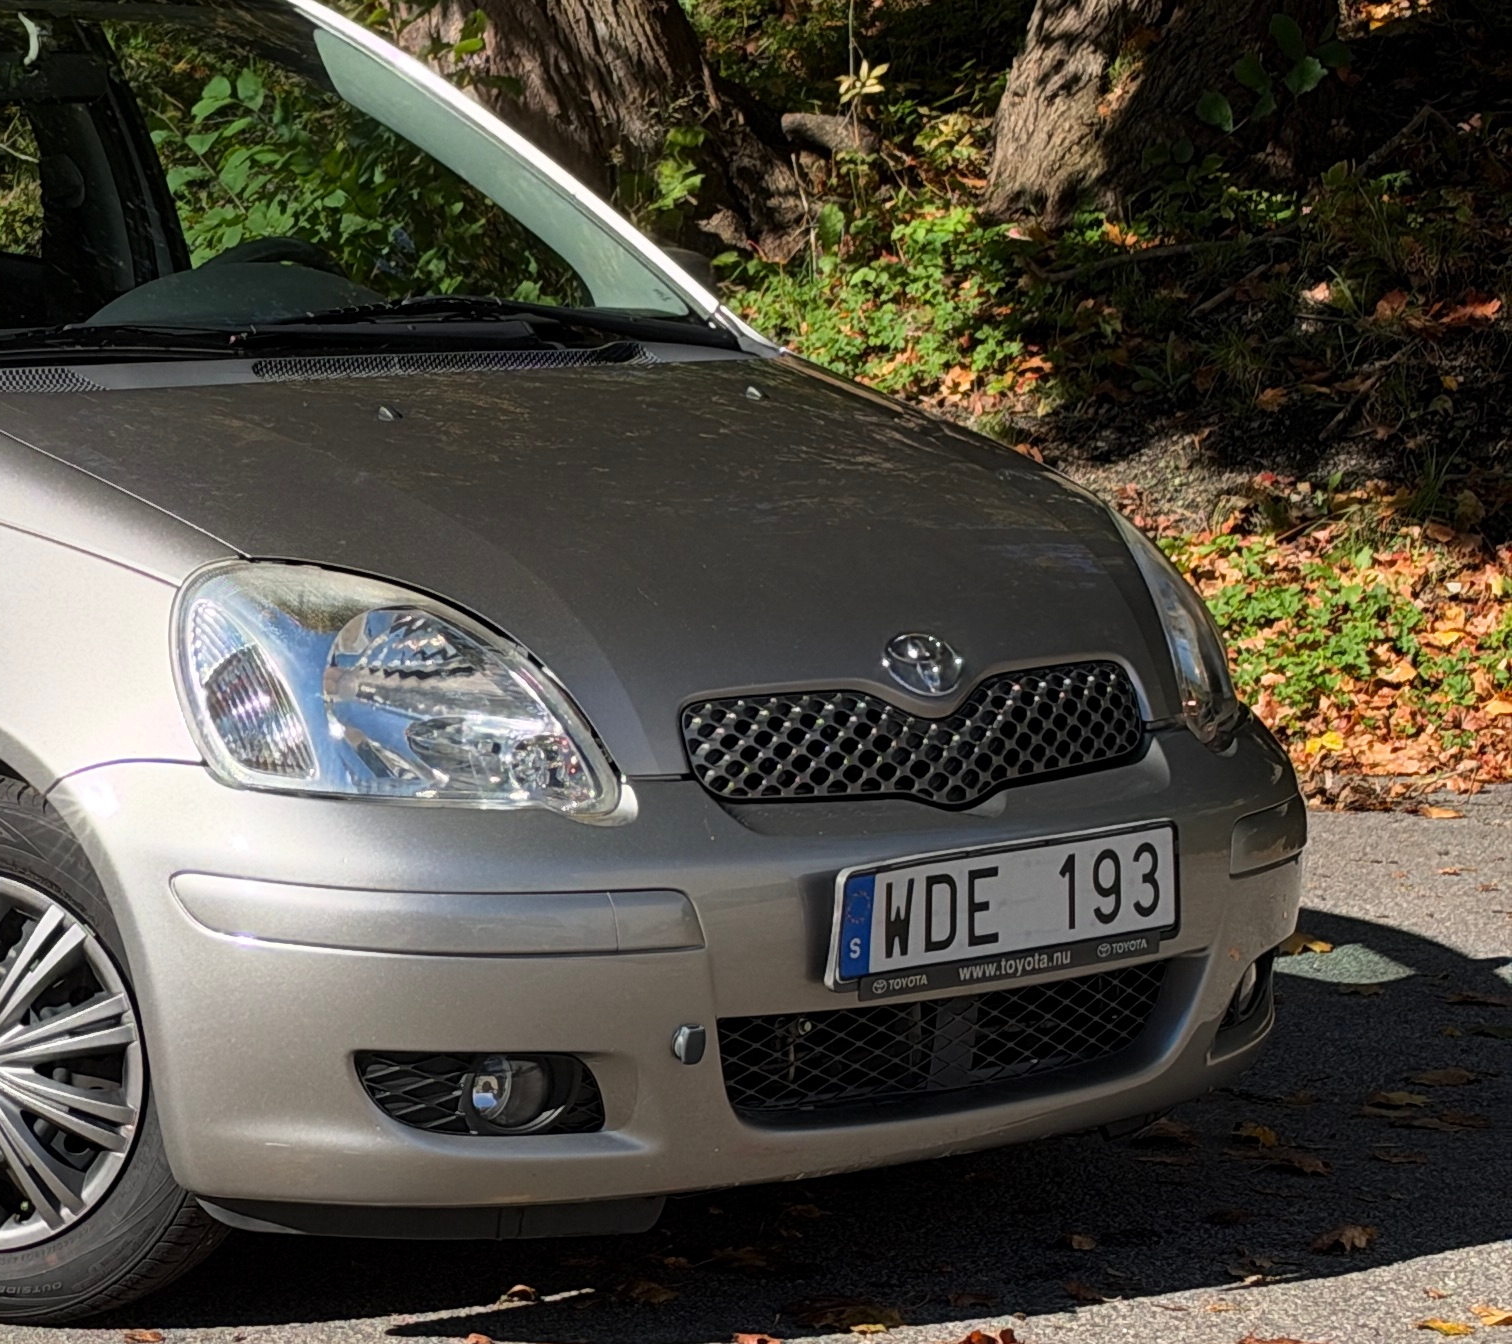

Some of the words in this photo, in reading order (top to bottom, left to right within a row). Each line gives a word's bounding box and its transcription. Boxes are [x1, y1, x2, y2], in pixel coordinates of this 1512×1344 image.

[884, 865, 1000, 960] WDE
[1058, 841, 1161, 931] 193
[848, 937, 862, 960] S
[1111, 938, 1148, 954] TOYOTA
[958, 950, 1072, 982] www.toyota.nu
[888, 974, 928, 992] TOYOTA
